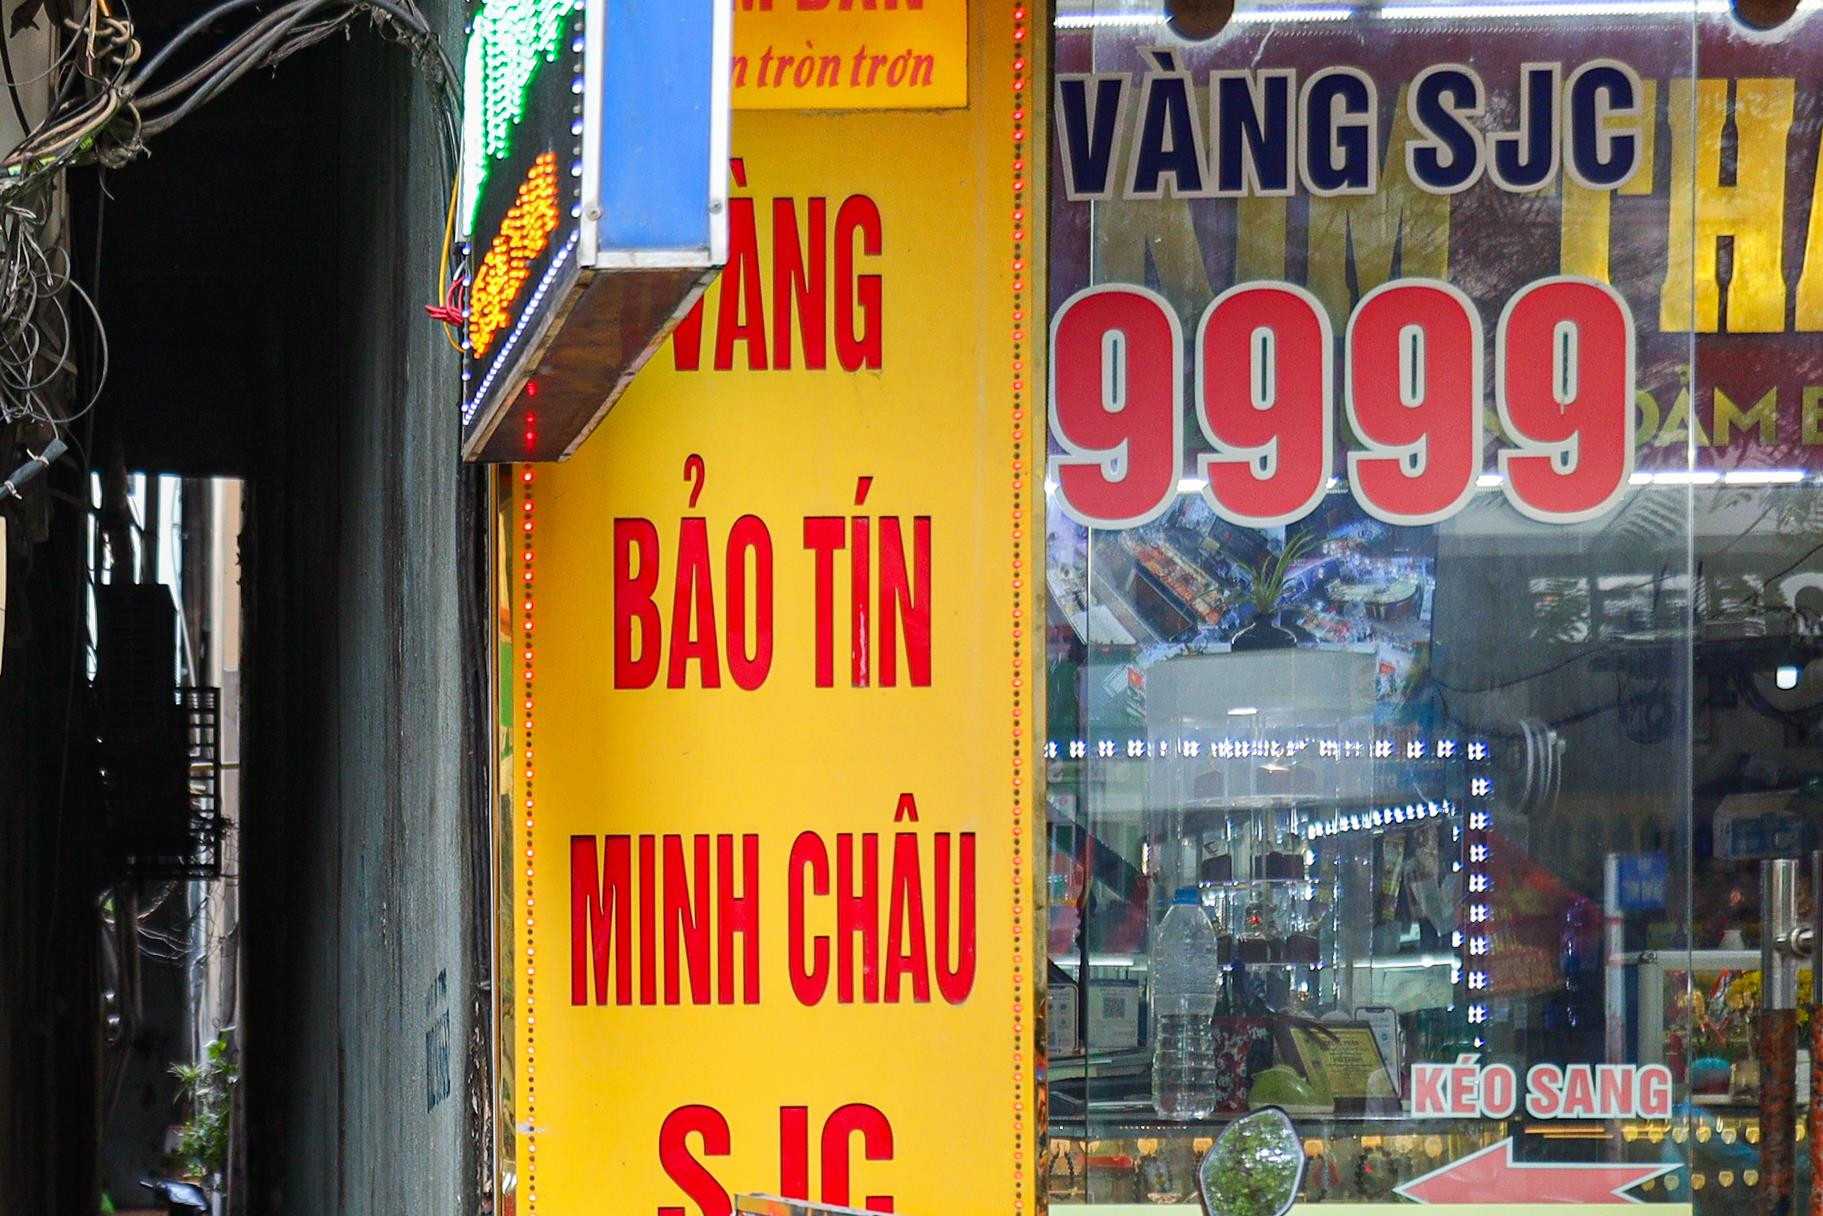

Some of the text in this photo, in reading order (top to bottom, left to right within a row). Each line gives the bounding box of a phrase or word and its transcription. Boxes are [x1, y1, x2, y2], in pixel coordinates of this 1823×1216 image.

[757, 40, 842, 89] tròn
[850, 44, 936, 89] trơn
[1056, 46, 1644, 201] VÀNG SJC
[1048, 275, 1636, 529] 9999
[612, 453, 932, 691] BẢO TÍN
[570, 793, 977, 1007] MINH CHÂU
[1412, 1050, 1518, 1119] KÉO
[1526, 1063, 1673, 1119] SANG
